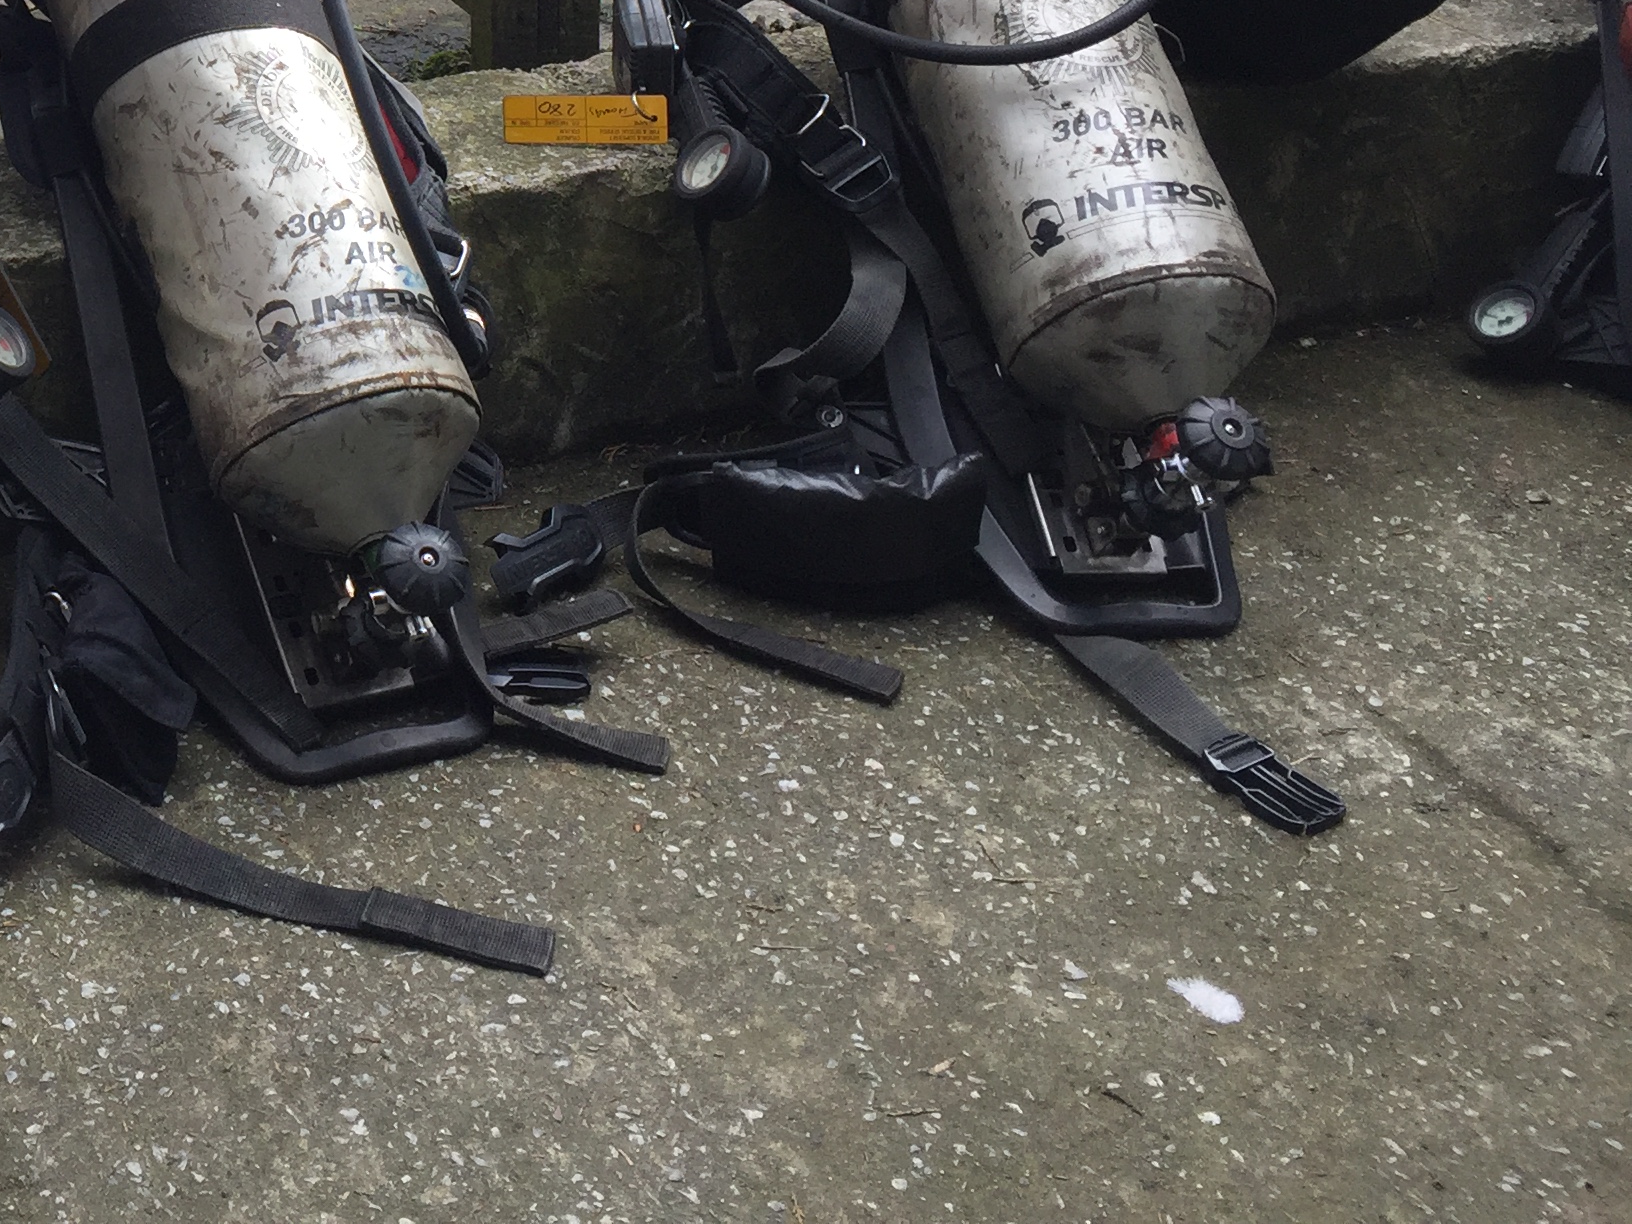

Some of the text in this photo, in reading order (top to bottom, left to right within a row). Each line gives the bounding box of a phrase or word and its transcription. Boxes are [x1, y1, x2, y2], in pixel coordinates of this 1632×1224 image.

[537, 101, 578, 119] 280
[1052, 107, 1187, 142] 300 BAR
[1109, 137, 1169, 165] AIR
[1074, 181, 1236, 221] INTERSP
[287, 207, 407, 240] 300 BAR
[345, 241, 397, 265] AIR
